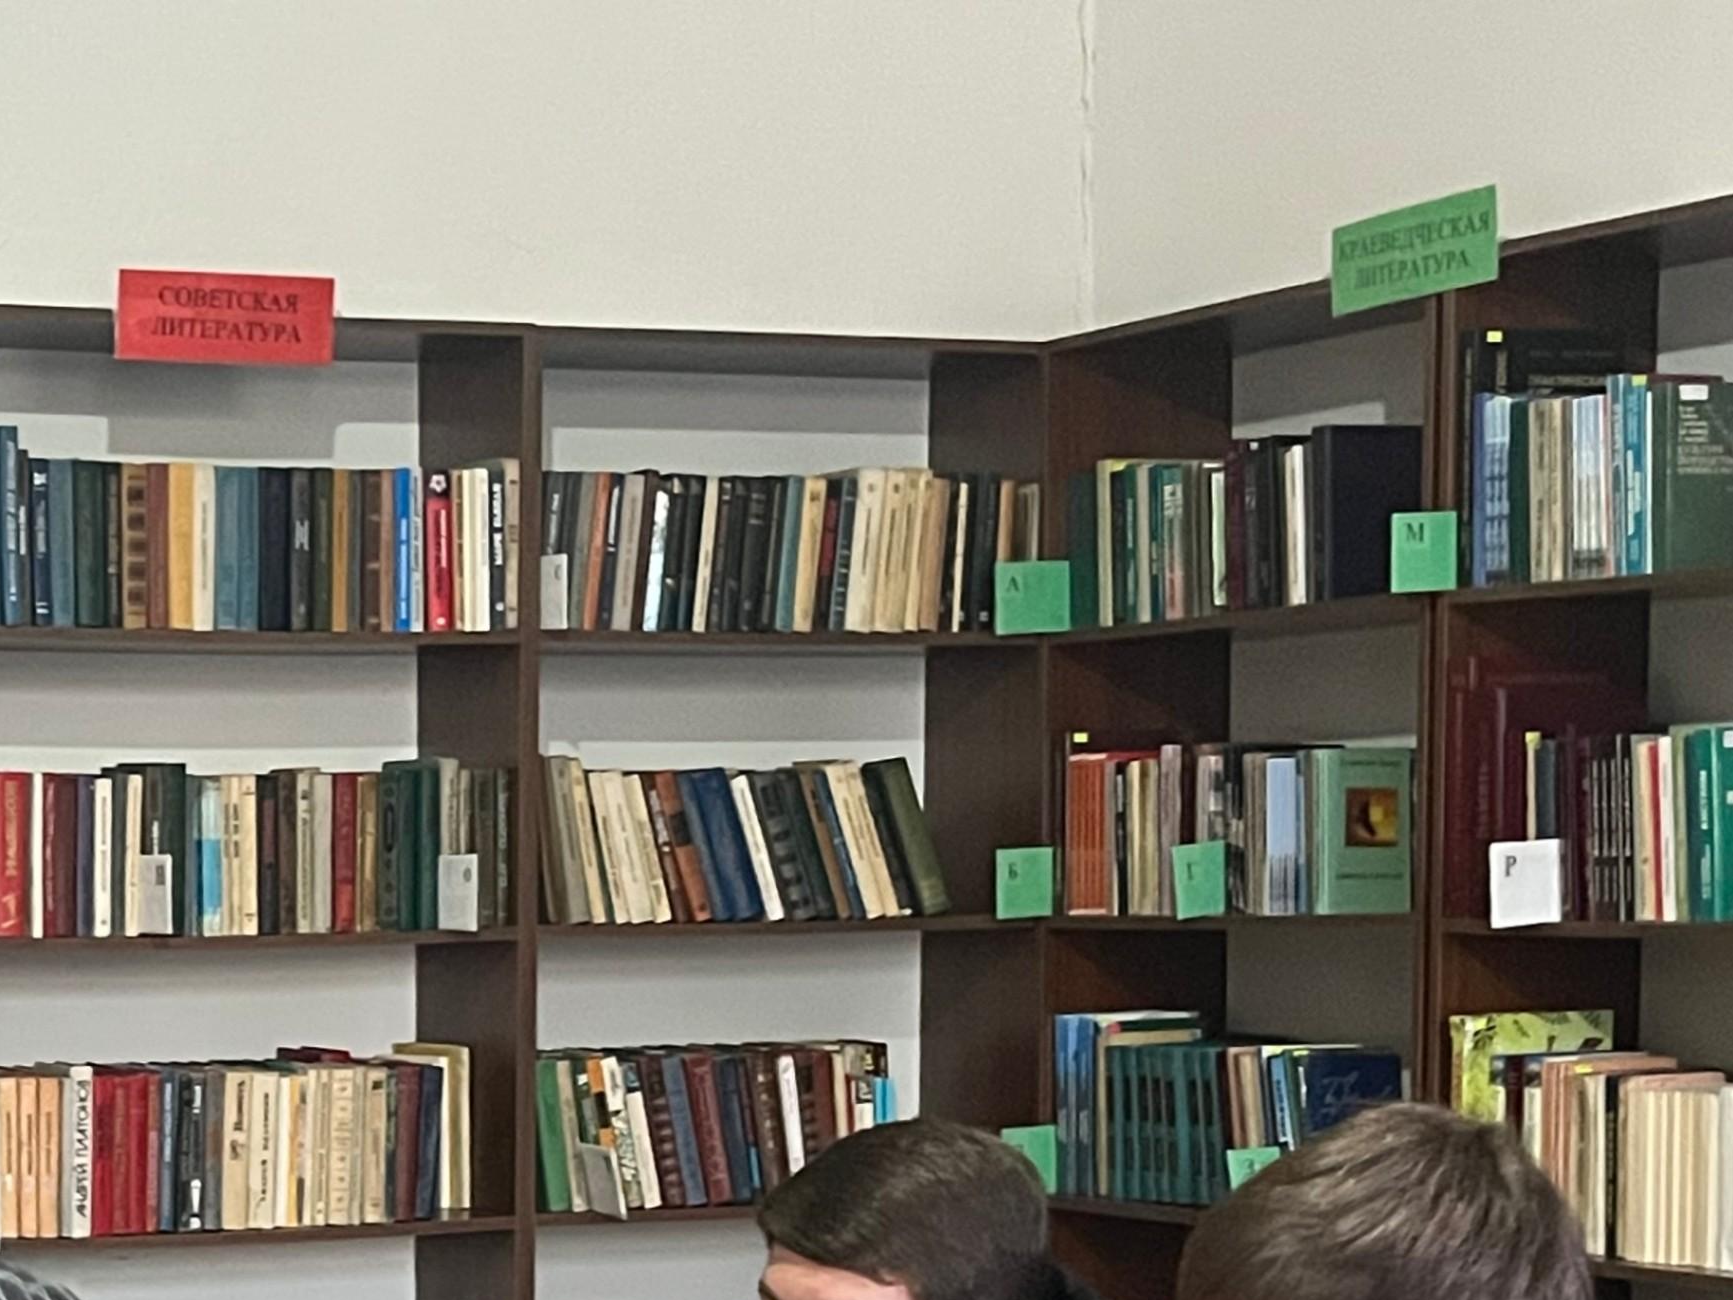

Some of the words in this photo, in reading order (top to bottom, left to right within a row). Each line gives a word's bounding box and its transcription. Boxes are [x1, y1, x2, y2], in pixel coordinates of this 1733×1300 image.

[1338, 211, 1490, 263] КРАЕВЕДЧЕСКАЯ
[1354, 249, 1471, 289] ЛИТЕРАТУРА
[157, 286, 299, 314] СОВЕТСКАЯ
[150, 316, 302, 344] ЛИТЕРАТУРА
[1404, 522, 1425, 543] М
[1005, 576, 1020, 592] А
[1008, 861, 1019, 880] Б
[1504, 855, 1517, 877] Р
